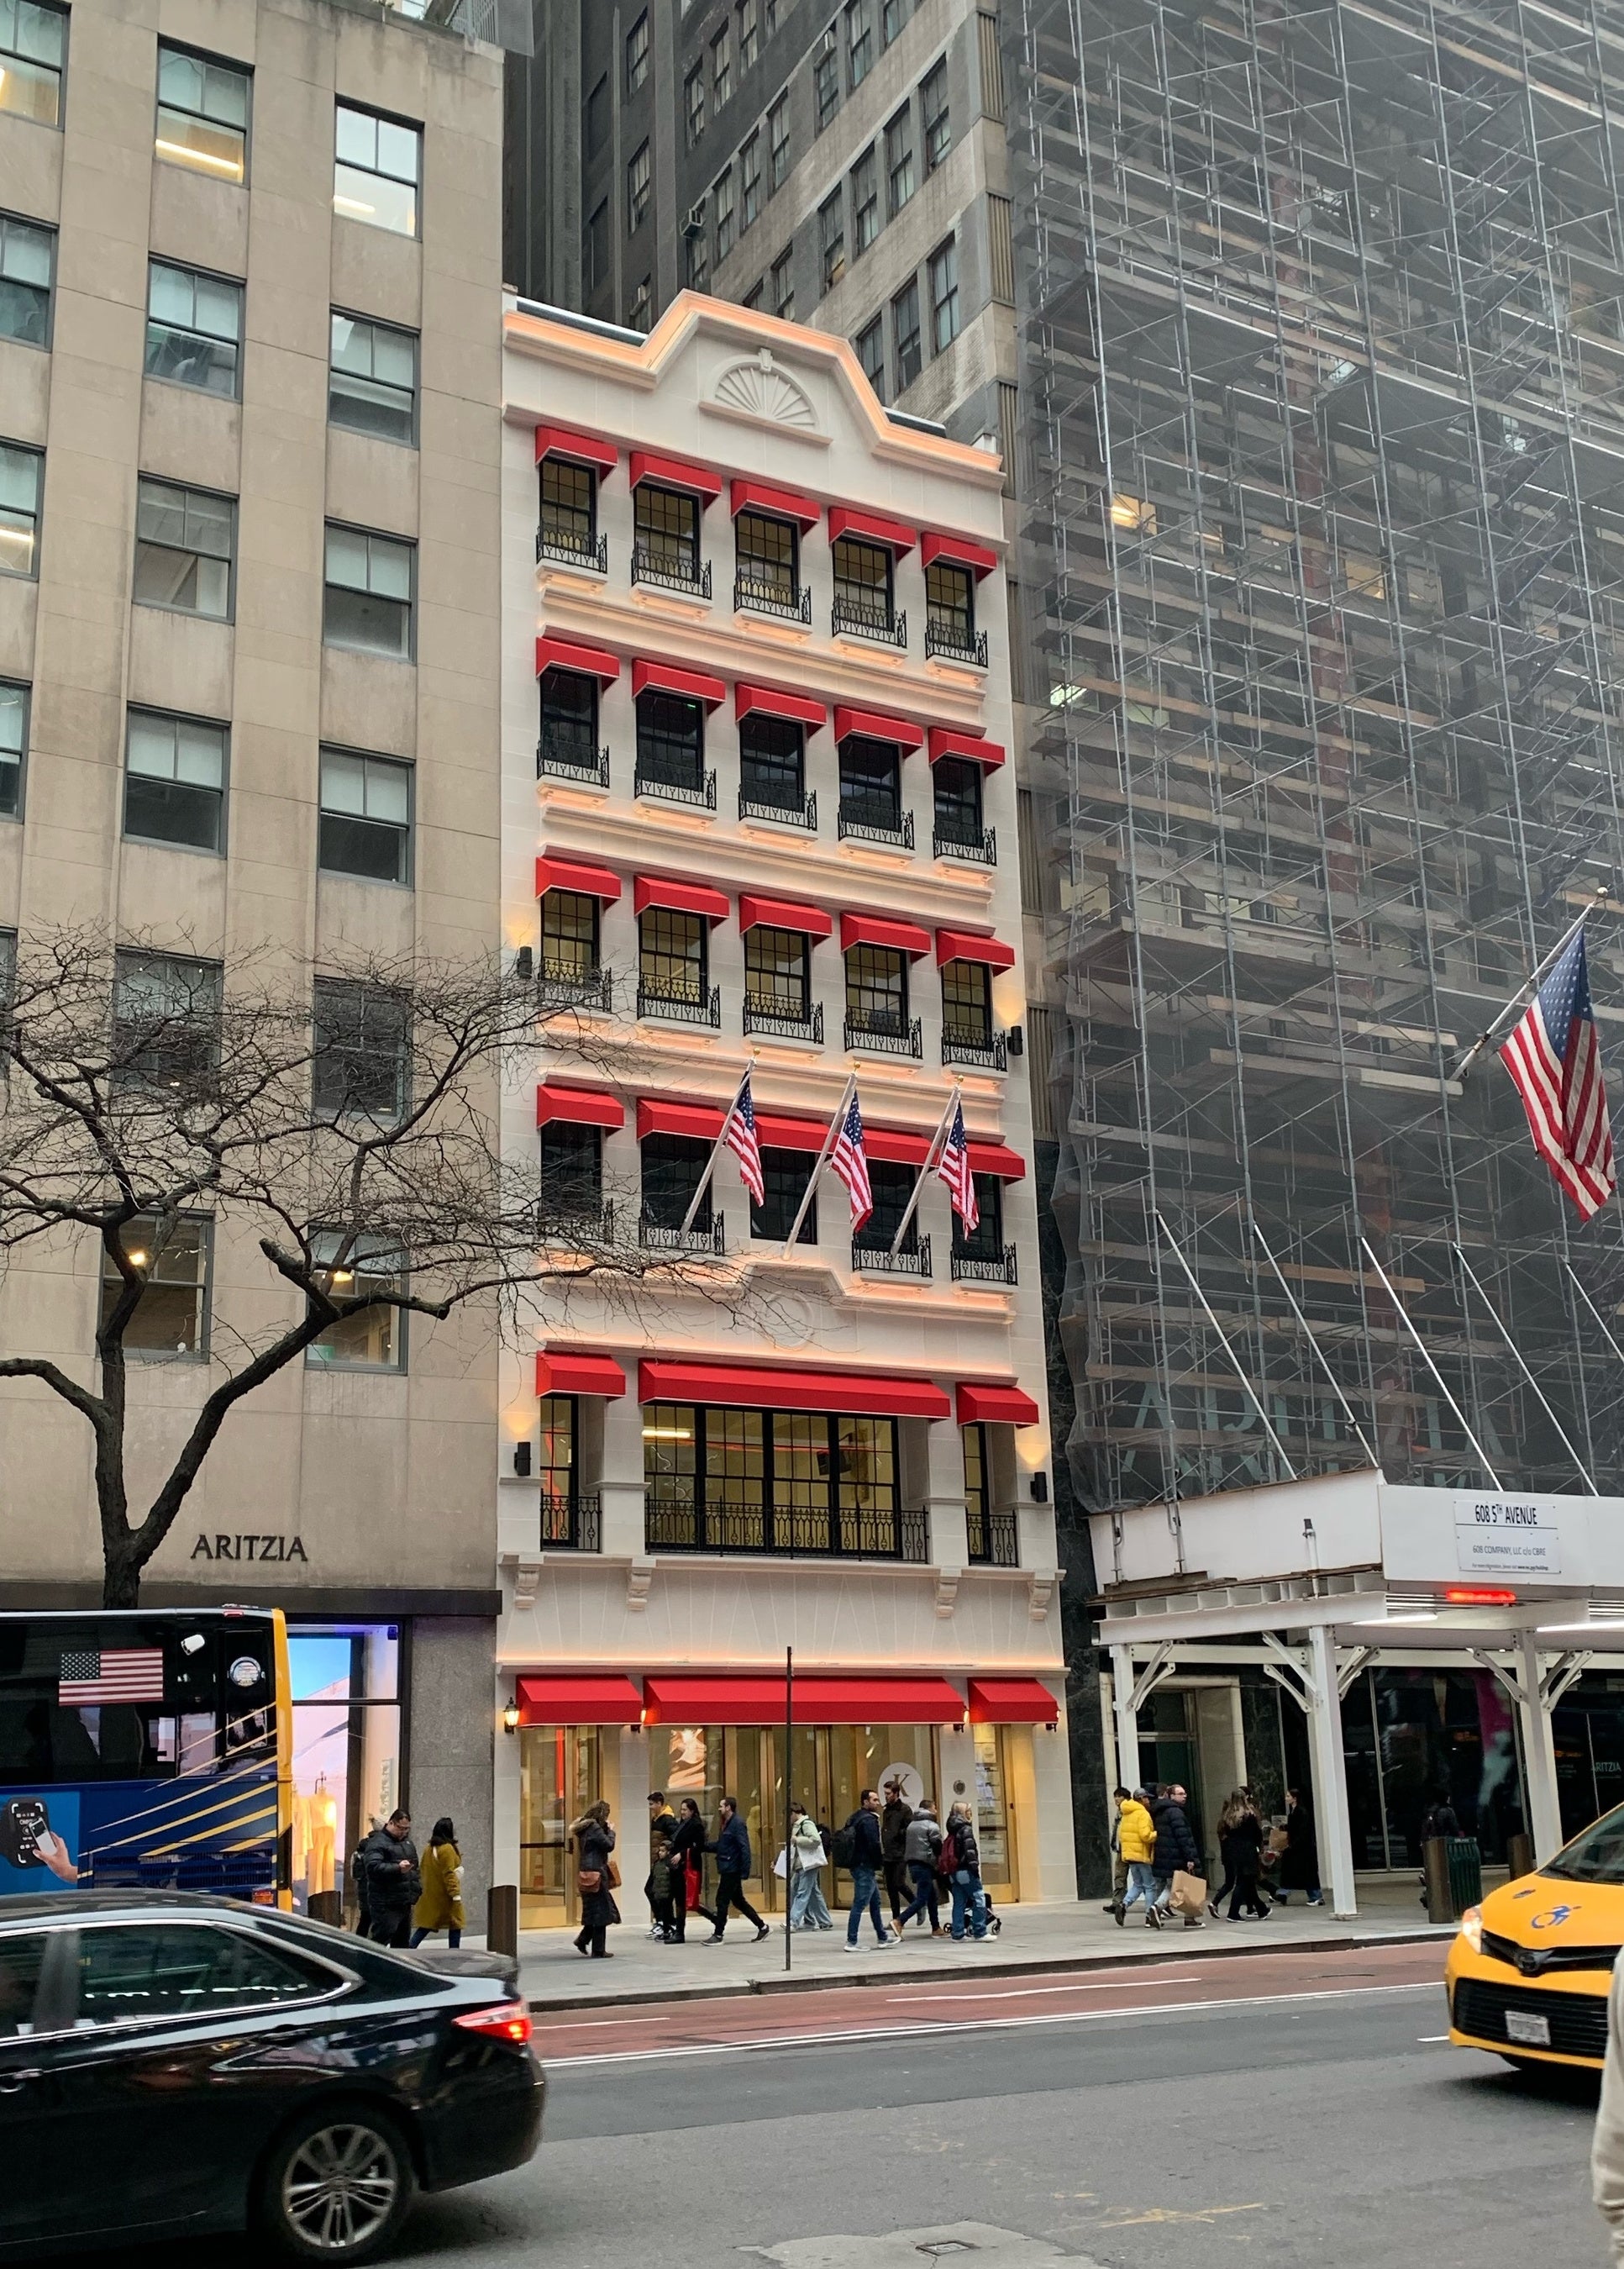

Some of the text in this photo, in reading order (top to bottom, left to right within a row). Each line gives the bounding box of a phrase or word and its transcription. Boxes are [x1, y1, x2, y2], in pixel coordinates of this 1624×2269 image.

[1474, 1504, 1490, 1523] 608
[1506, 1506, 1537, 1524] AVENUE
[191, 1535, 307, 1561] ARITZIA
[893, 1773, 910, 1797] K
